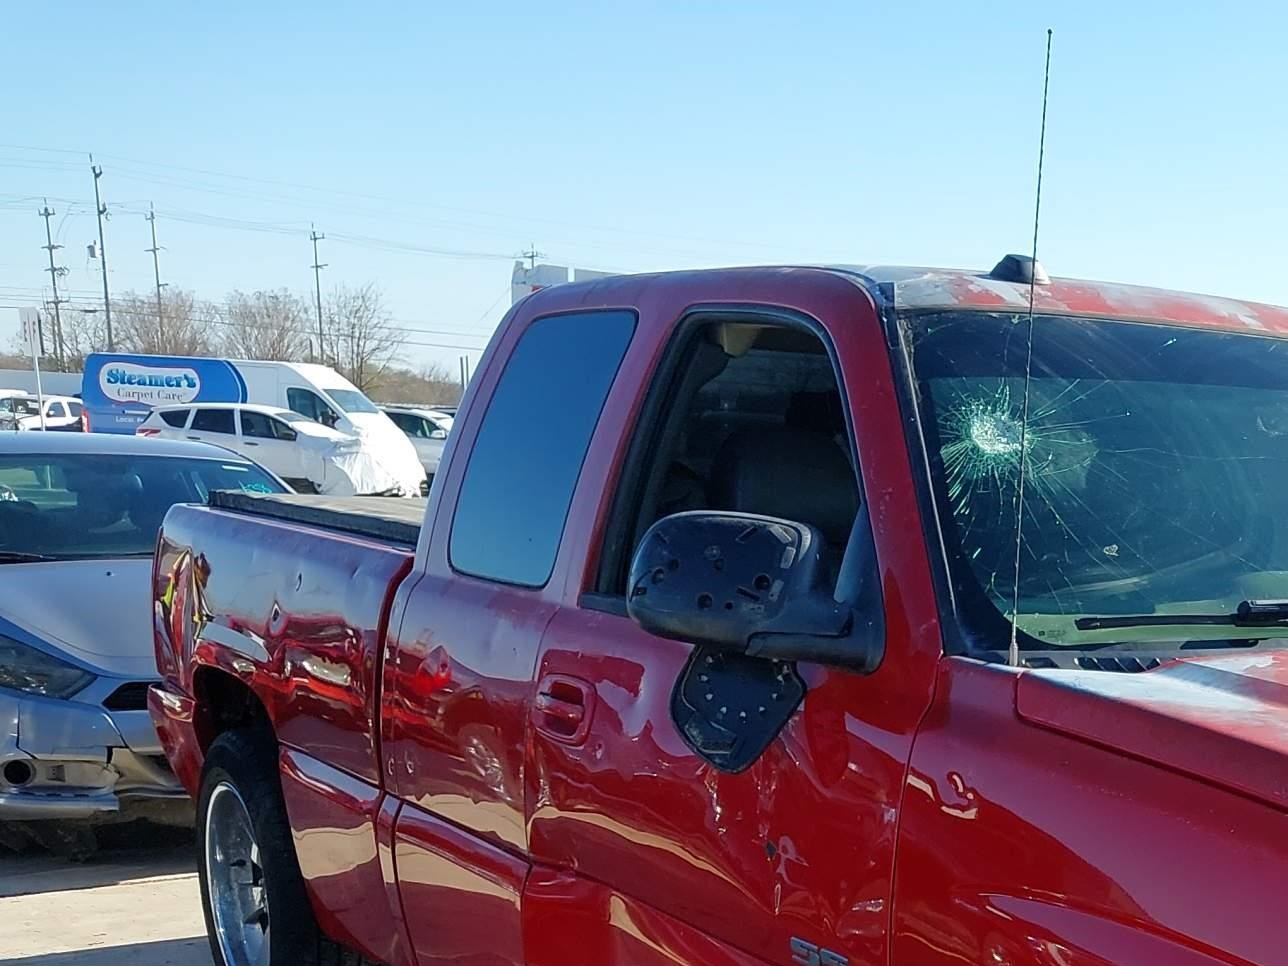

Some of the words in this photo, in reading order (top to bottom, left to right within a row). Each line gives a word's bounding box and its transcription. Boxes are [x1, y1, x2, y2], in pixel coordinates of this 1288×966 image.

[106, 368, 197, 389] Steamer's
[117, 386, 154, 401] Carpet
[157, 389, 184, 401] Care
